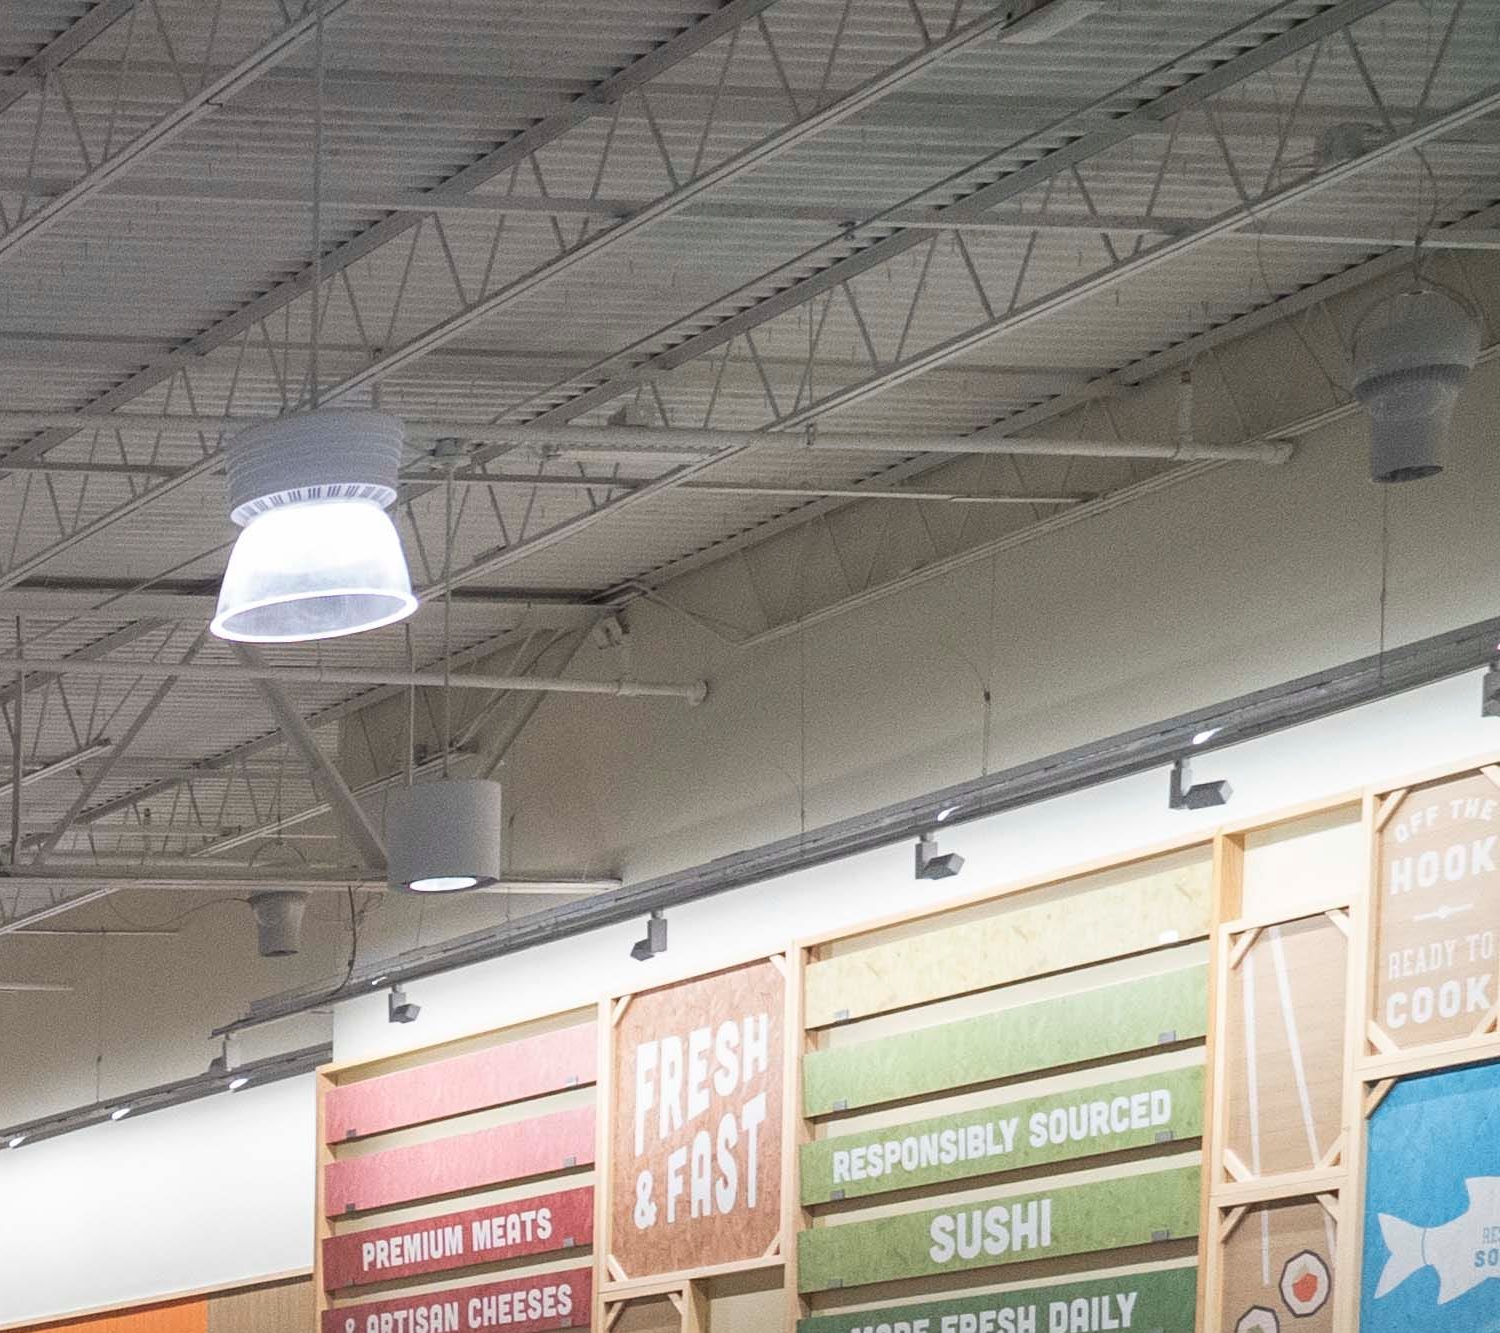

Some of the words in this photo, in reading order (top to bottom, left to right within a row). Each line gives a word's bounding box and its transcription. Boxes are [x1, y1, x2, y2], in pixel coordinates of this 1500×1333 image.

[1393, 804, 1440, 843] OFF
[1451, 796, 1498, 821] THE
[1388, 834, 1500, 896] HOOK
[1388, 937, 1455, 981] READY
[1465, 930, 1495, 962] TO
[1385, 974, 1493, 1029] COOK
[634, 1012, 768, 1157] FRESH
[633, 1169, 657, 1230] &
[666, 1092, 767, 1224] FAST
[832, 1117, 1020, 1185] RESPONSIBLY
[1029, 1088, 1172, 1149] SOURCED
[362, 1225, 464, 1272] PREMIUM
[471, 1207, 552, 1251] MEATS
[929, 1198, 1052, 1264] SUSHI
[467, 1284, 573, 1329] CHEESES
